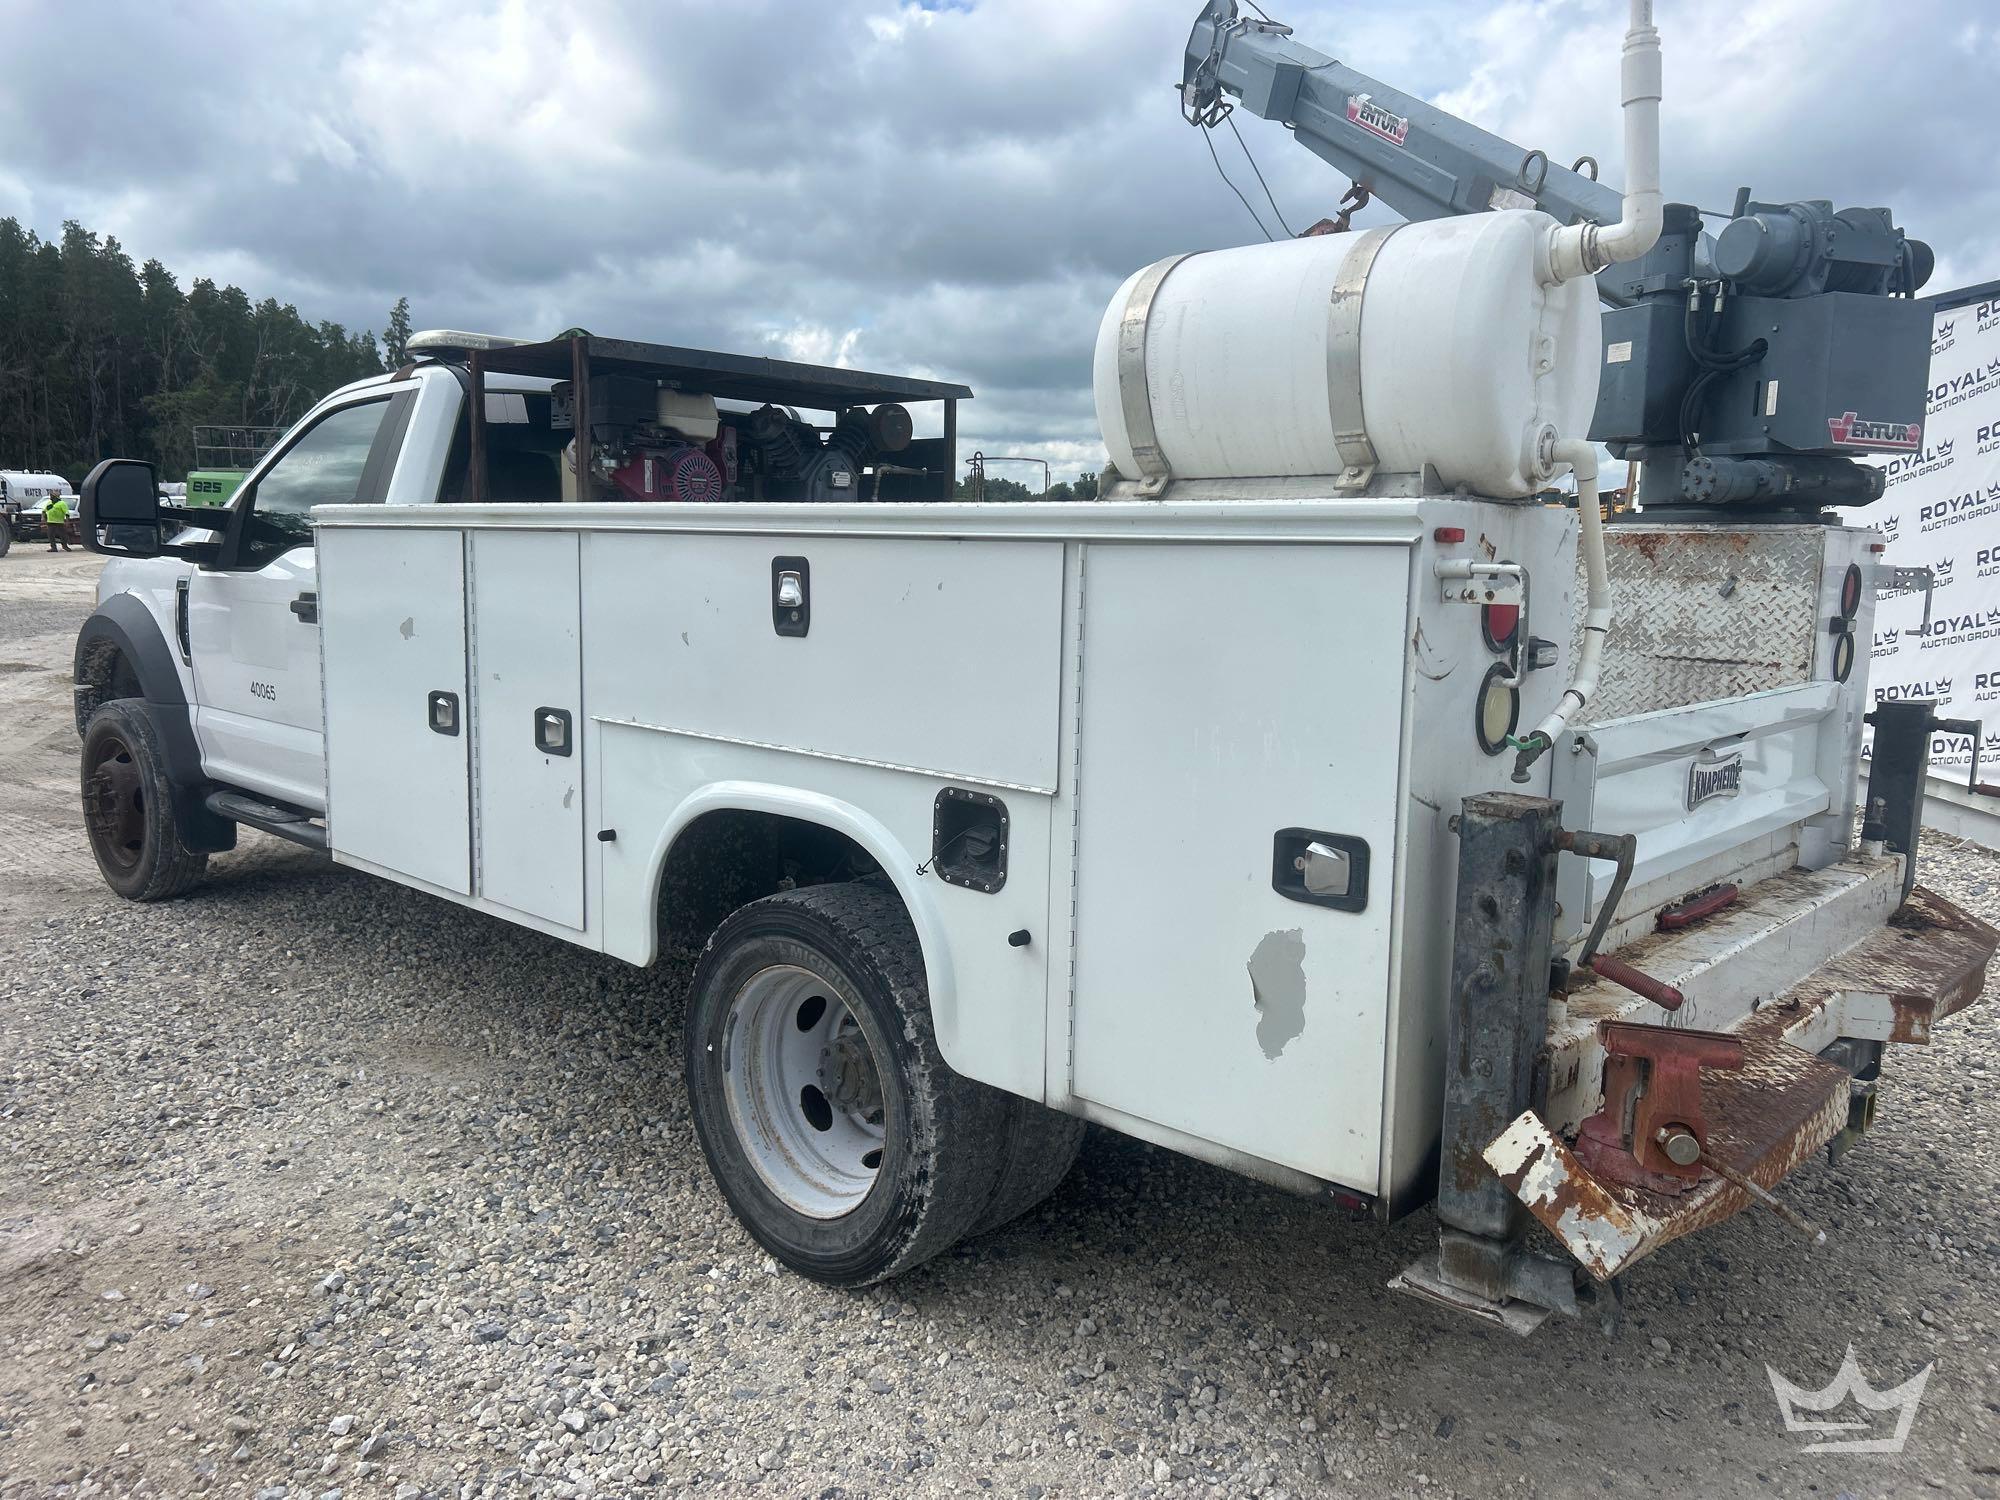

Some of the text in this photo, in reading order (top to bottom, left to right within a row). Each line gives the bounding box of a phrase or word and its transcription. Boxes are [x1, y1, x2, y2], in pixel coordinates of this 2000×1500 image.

[1931, 339, 1955, 356] OUP
[1926, 368, 1986, 403] ROYAL
[1926, 378, 2000, 415] UCTION GROU
[1829, 412, 1920, 442] VENTURO
[1918, 457, 1954, 476] GROUP
[1920, 490, 1986, 522] ROYAL
[1920, 502, 2000, 533] AUCTION GROU
[1920, 613, 1985, 638] ROYAL
[1920, 634, 1965, 650] AUCTION
[250, 681, 275, 701] 40065
[1874, 682, 1935, 702] ROYAL
[1932, 737, 1984, 754] OYA
[1964, 753, 2000, 764] GOUP
[1695, 758, 1742, 802] KNAPHEIDE
[790, 944, 859, 1005] MICHELIN
